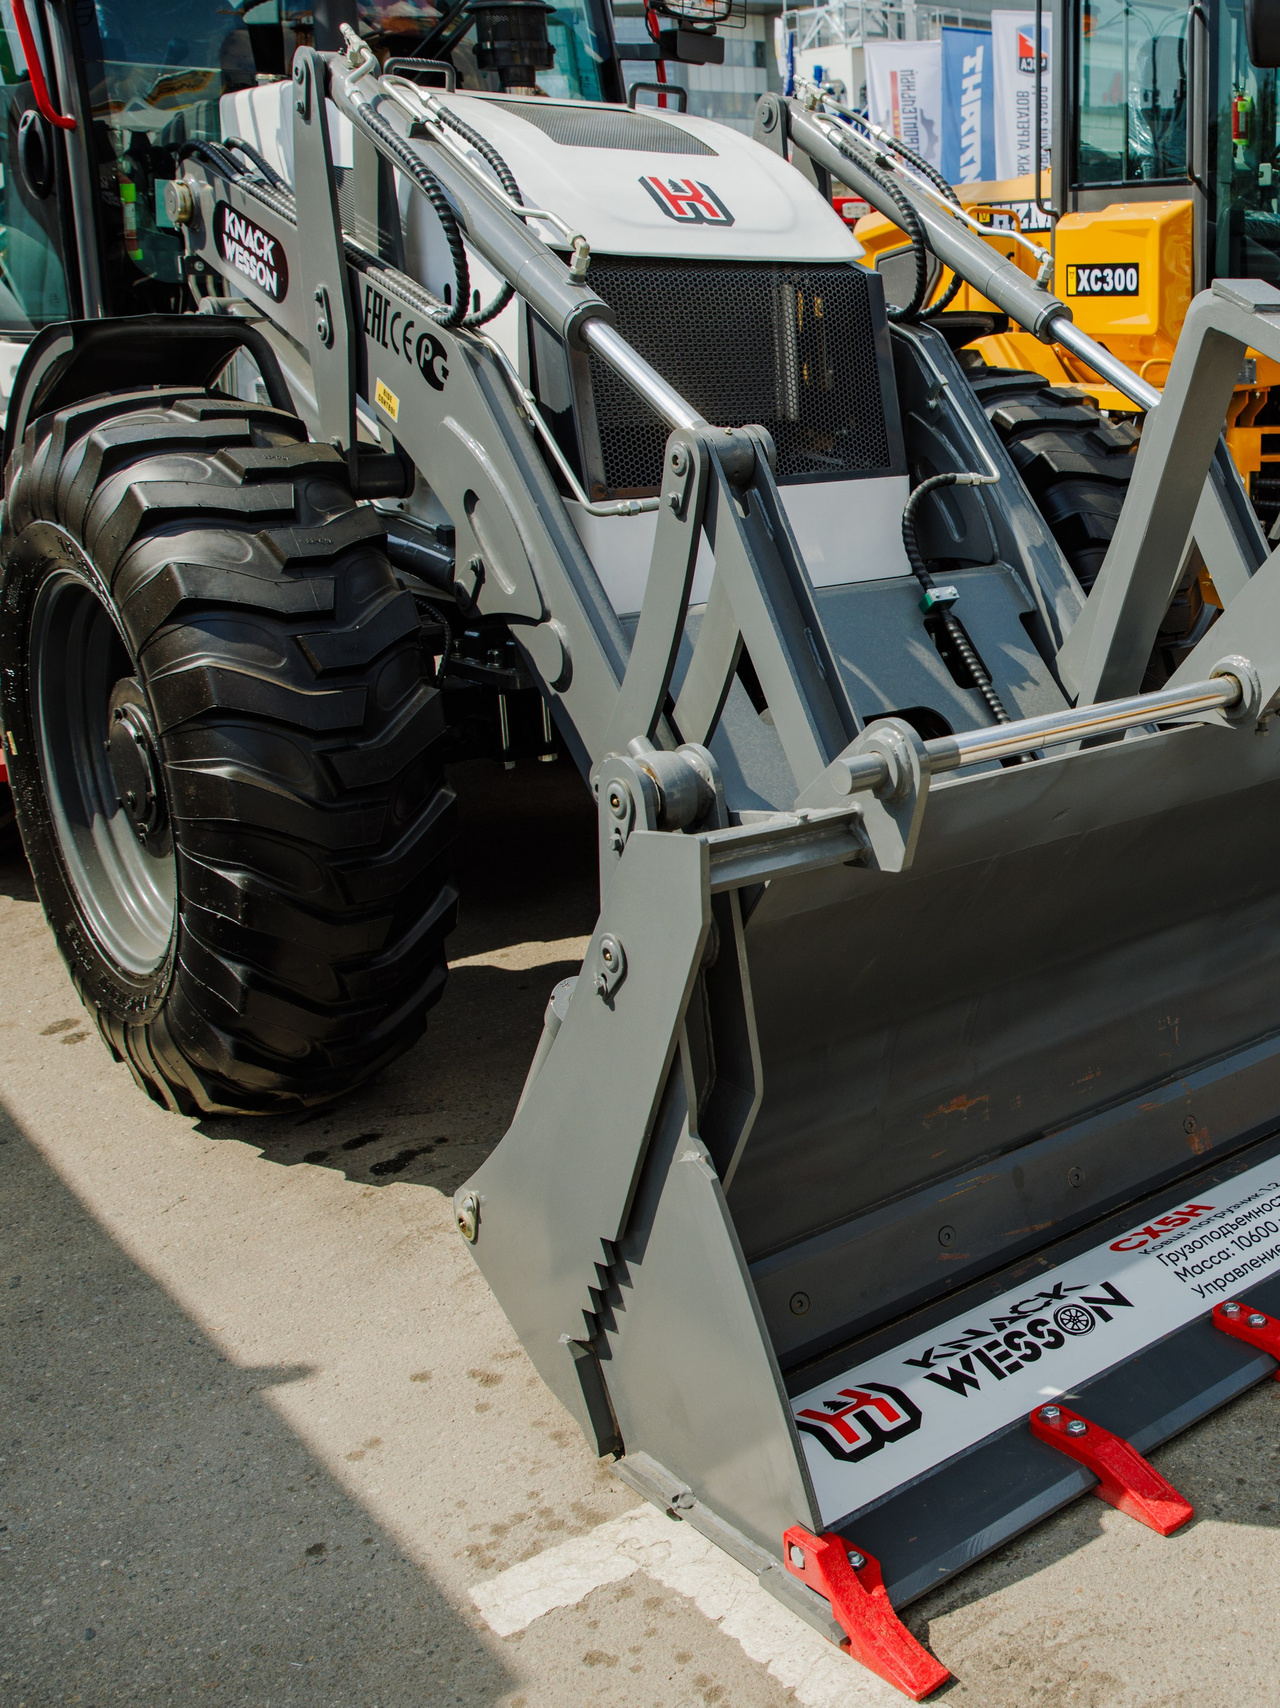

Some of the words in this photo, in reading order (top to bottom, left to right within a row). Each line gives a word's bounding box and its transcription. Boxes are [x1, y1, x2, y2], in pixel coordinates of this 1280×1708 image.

[222, 233, 278, 297] WESSON
[224, 207, 275, 267] KNACK
[1077, 268, 1138, 292] XC300
[1109, 1203, 1216, 1252] CX5H
[1138, 1230, 1191, 1256] Ковш:
[1192, 1191, 1264, 1230] погрузчик
[1173, 1247, 1235, 1283] Масса:
[1230, 1220, 1279, 1252] 10600
[902, 1280, 1090, 1370] KNACK
[923, 1280, 1135, 1398] WESSON
